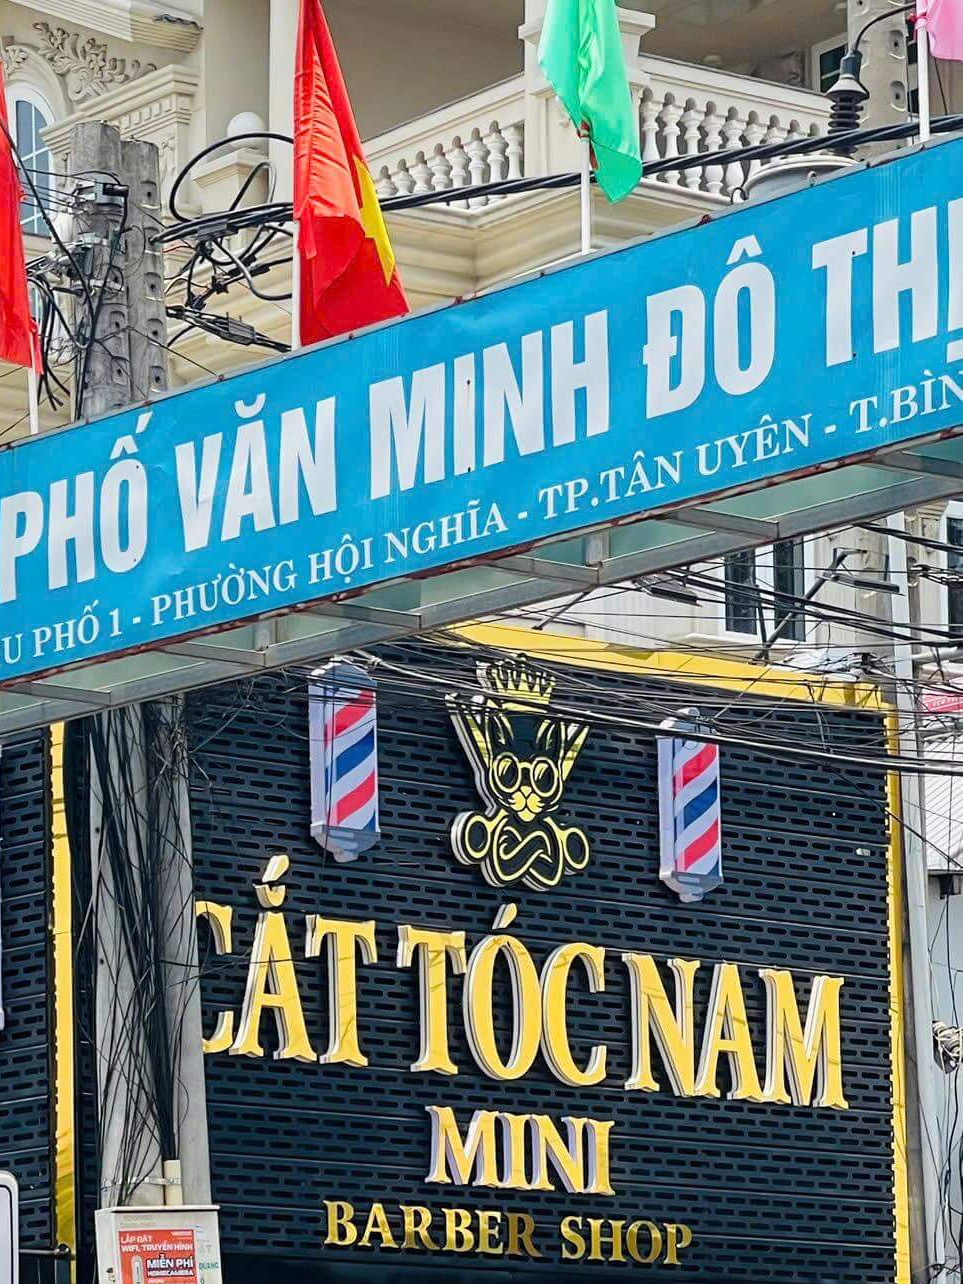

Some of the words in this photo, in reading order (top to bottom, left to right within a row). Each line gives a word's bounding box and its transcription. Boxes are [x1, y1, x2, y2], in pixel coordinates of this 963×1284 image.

[174, 393, 336, 552] VĂN
[368, 308, 611, 500] MINH
[643, 235, 776, 420] ĐÔ
[32, 600, 101, 656] PHỐ
[110, 608, 123, 637] 1
[151, 561, 295, 628] PHƯỜNG
[308, 533, 374, 582] HỘI
[384, 500, 507, 564] NGHĨA
[539, 450, 684, 522] TP.TÂN
[697, 410, 812, 477] UYÊN
[396, 903, 607, 1088] TÓC
[622, 952, 850, 1110] NAM
[426, 1105, 615, 1196] MINI
[176, 1256, 194, 1268] PHÍ
[323, 1200, 542, 1259] BARBER
[562, 1216, 693, 1266] SHOP
